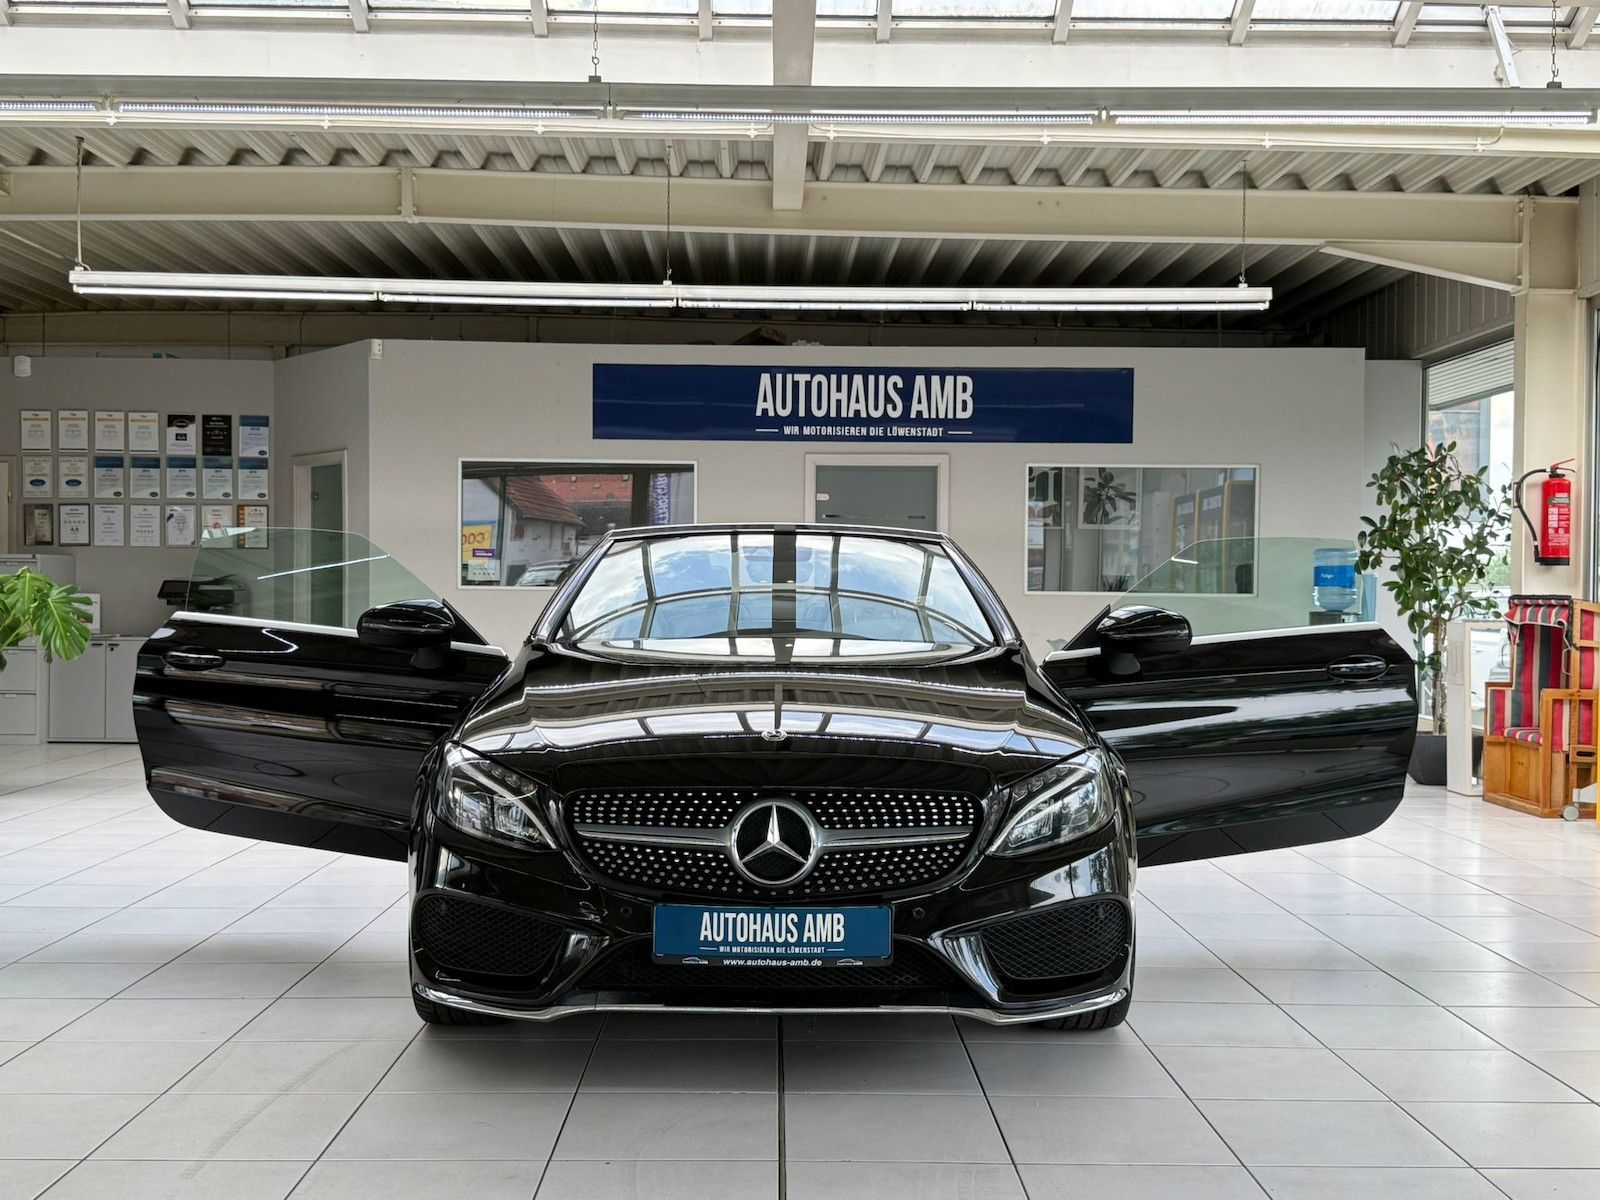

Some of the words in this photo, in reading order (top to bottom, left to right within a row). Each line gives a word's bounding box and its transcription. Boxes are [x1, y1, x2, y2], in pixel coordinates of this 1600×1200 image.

[755, 373, 904, 419] AUTOHAUS
[909, 375, 975, 420] AMB
[783, 425, 799, 436] WIR
[802, 425, 867, 437] MOTORISIEREN
[870, 426, 884, 437] DIE
[886, 425, 944, 438] LÖWENSTADT
[699, 911, 799, 943] AUTOHAUS
[802, 913, 846, 943] AMB
[718, 945, 731, 953] WIR
[732, 945, 775, 954] MOTORISIEREN
[775, 946, 786, 954] DIE
[787, 945, 825, 955] LÖWENSTADT
[722, 958, 823, 968] www.autohaus-amb.de
